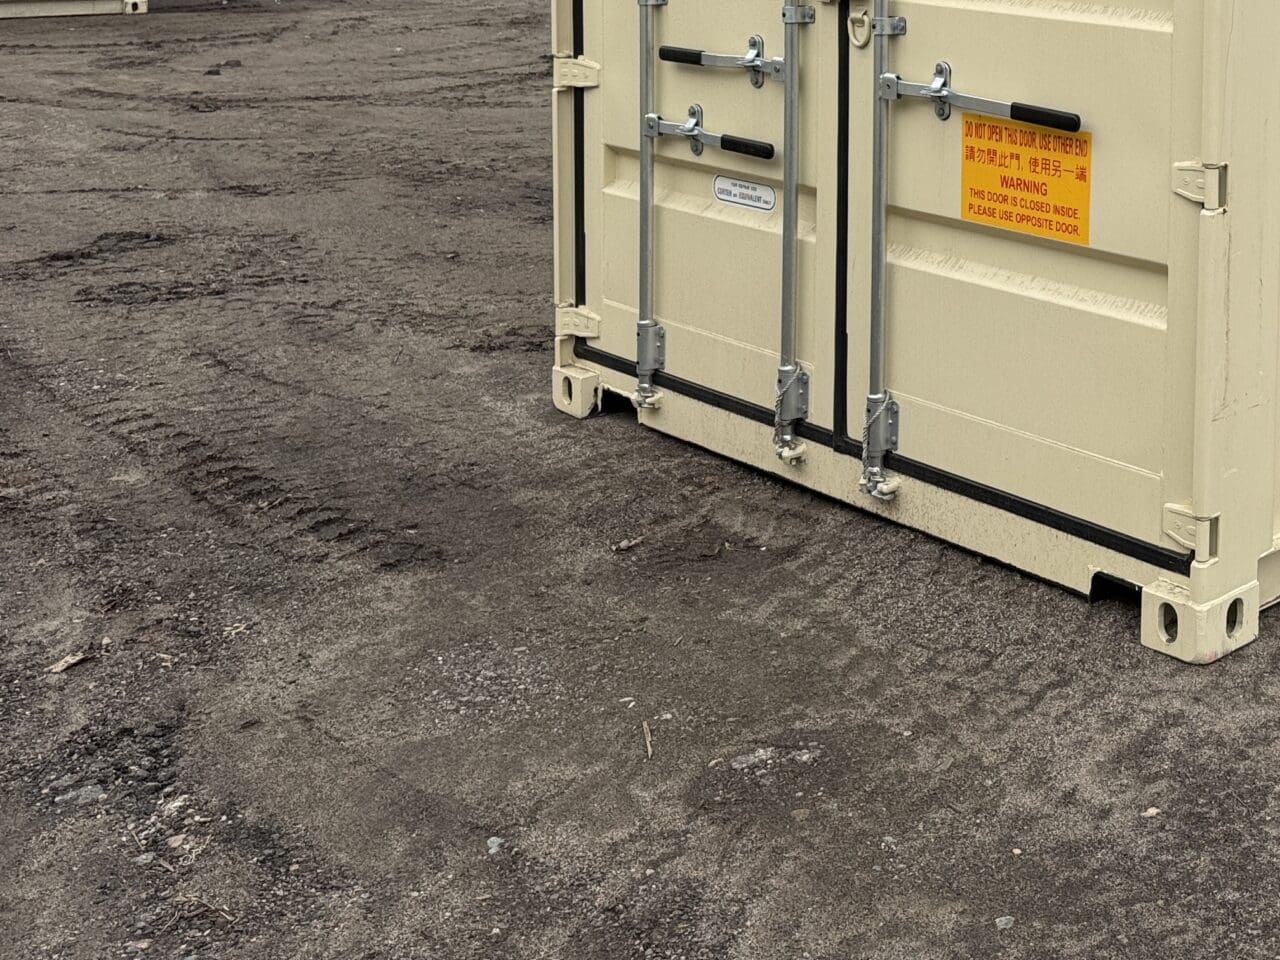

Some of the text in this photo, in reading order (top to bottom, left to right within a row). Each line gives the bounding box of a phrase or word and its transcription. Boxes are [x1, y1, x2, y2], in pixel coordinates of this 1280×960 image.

[965, 120, 973, 138] DO
[974, 122, 986, 139] NOT
[987, 124, 1003, 142] OPEN
[1004, 126, 1018, 145] THIS
[1039, 132, 1051, 152] USE
[1052, 135, 1073, 155] OTHER
[1075, 139, 1088, 157] END
[1000, 174, 1048, 196] WARNING
[968, 203, 1080, 236] PLEASE USE OPPOSITE DOOR.
[969, 188, 1080, 220] THIS DOOR IS CLOSED INSIDE.
